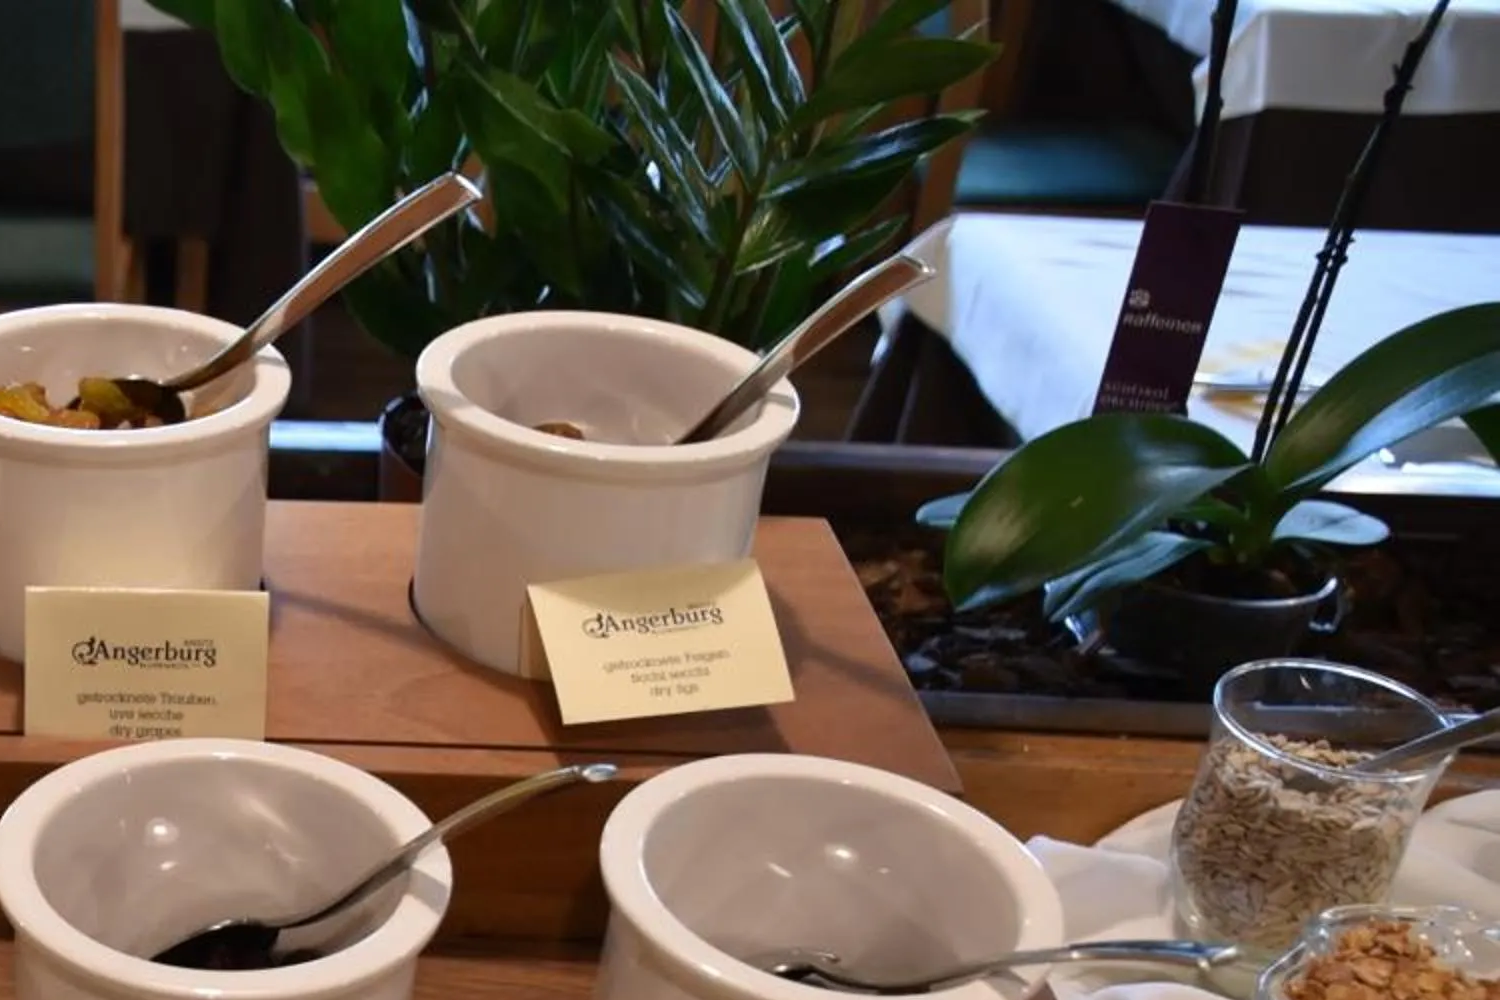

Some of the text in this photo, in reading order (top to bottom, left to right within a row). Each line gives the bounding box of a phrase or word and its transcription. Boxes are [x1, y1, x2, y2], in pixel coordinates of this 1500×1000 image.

[582, 606, 724, 638] Angerburg
[72, 636, 217, 668] Angerburg
[110, 724, 132, 738] dry
